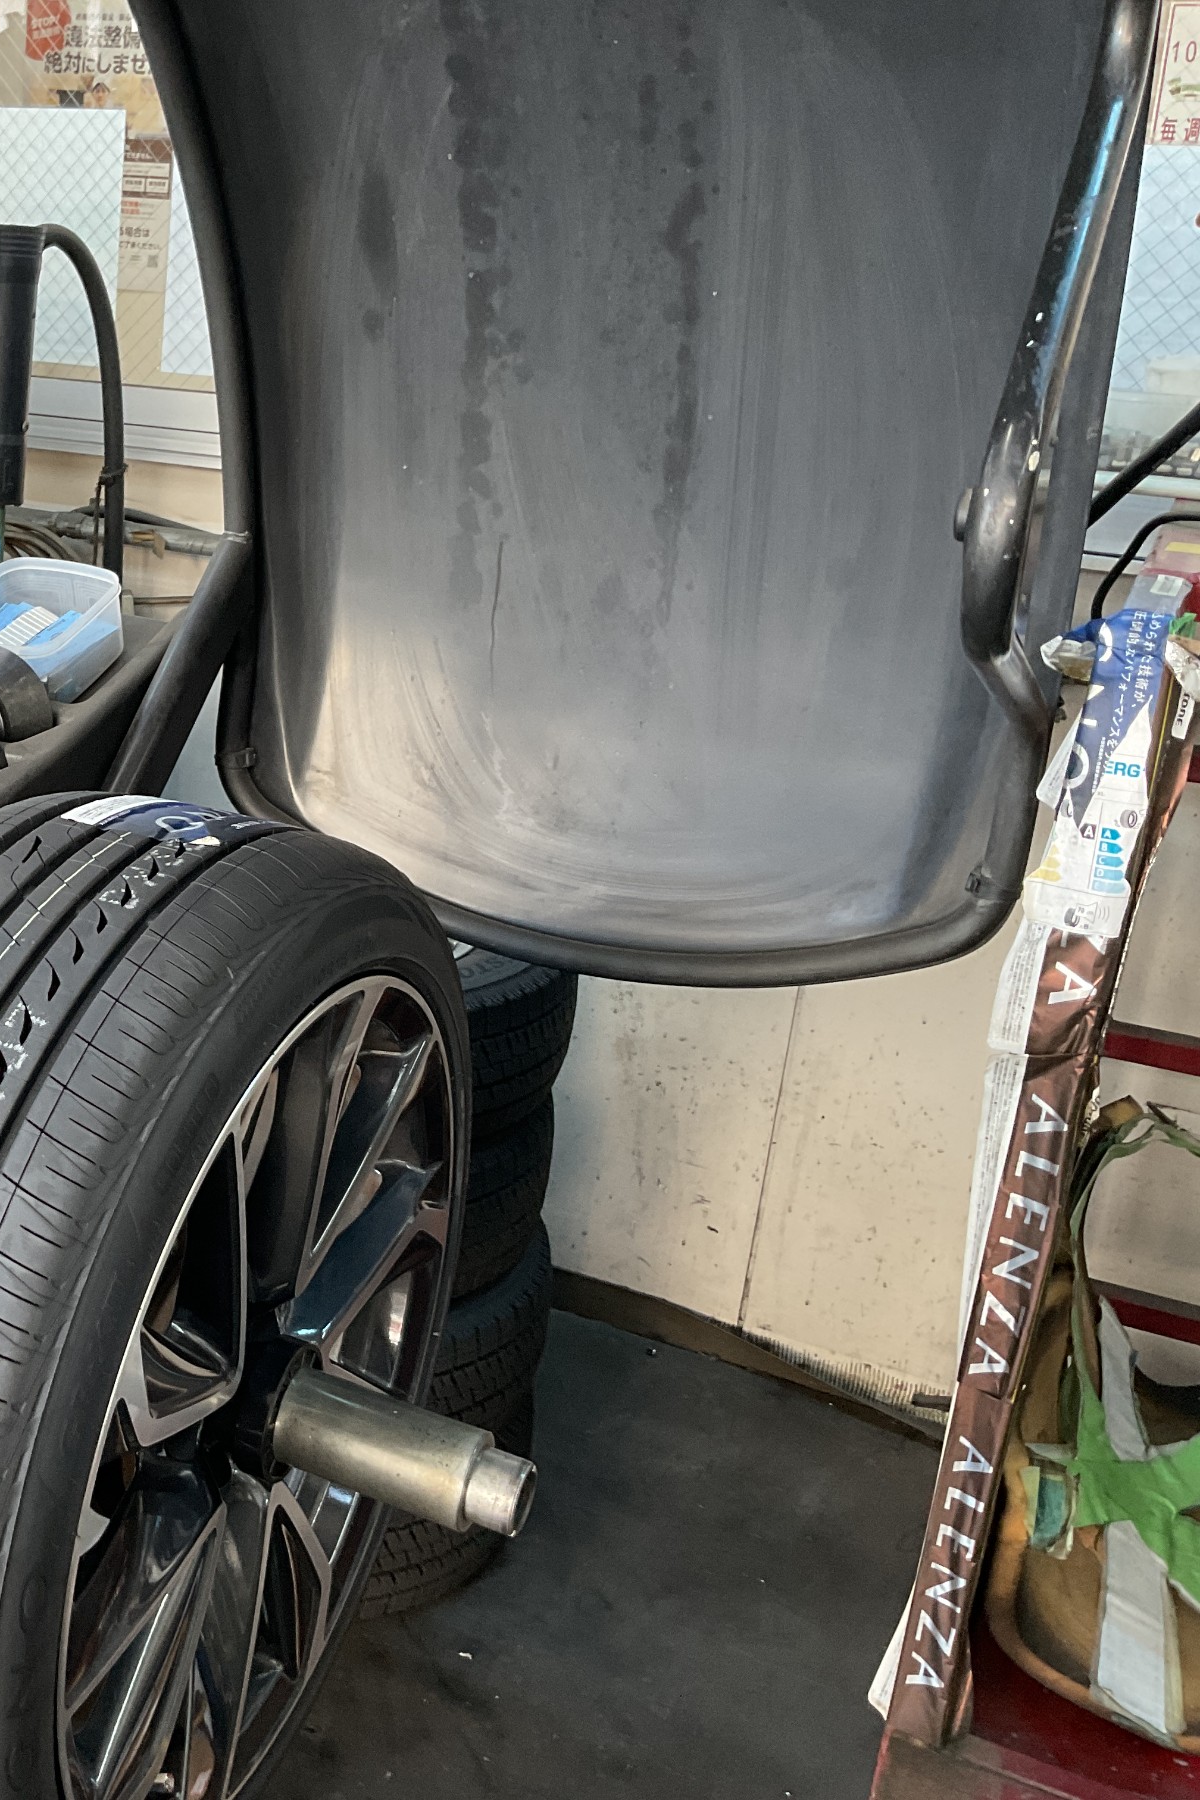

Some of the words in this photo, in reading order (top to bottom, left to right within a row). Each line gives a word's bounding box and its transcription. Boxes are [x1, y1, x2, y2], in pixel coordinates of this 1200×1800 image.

[43, 51, 152, 75] 絶対にしませ
[968, 1093, 1069, 1375] ALENZA
[904, 1435, 994, 1689] ALENZA
